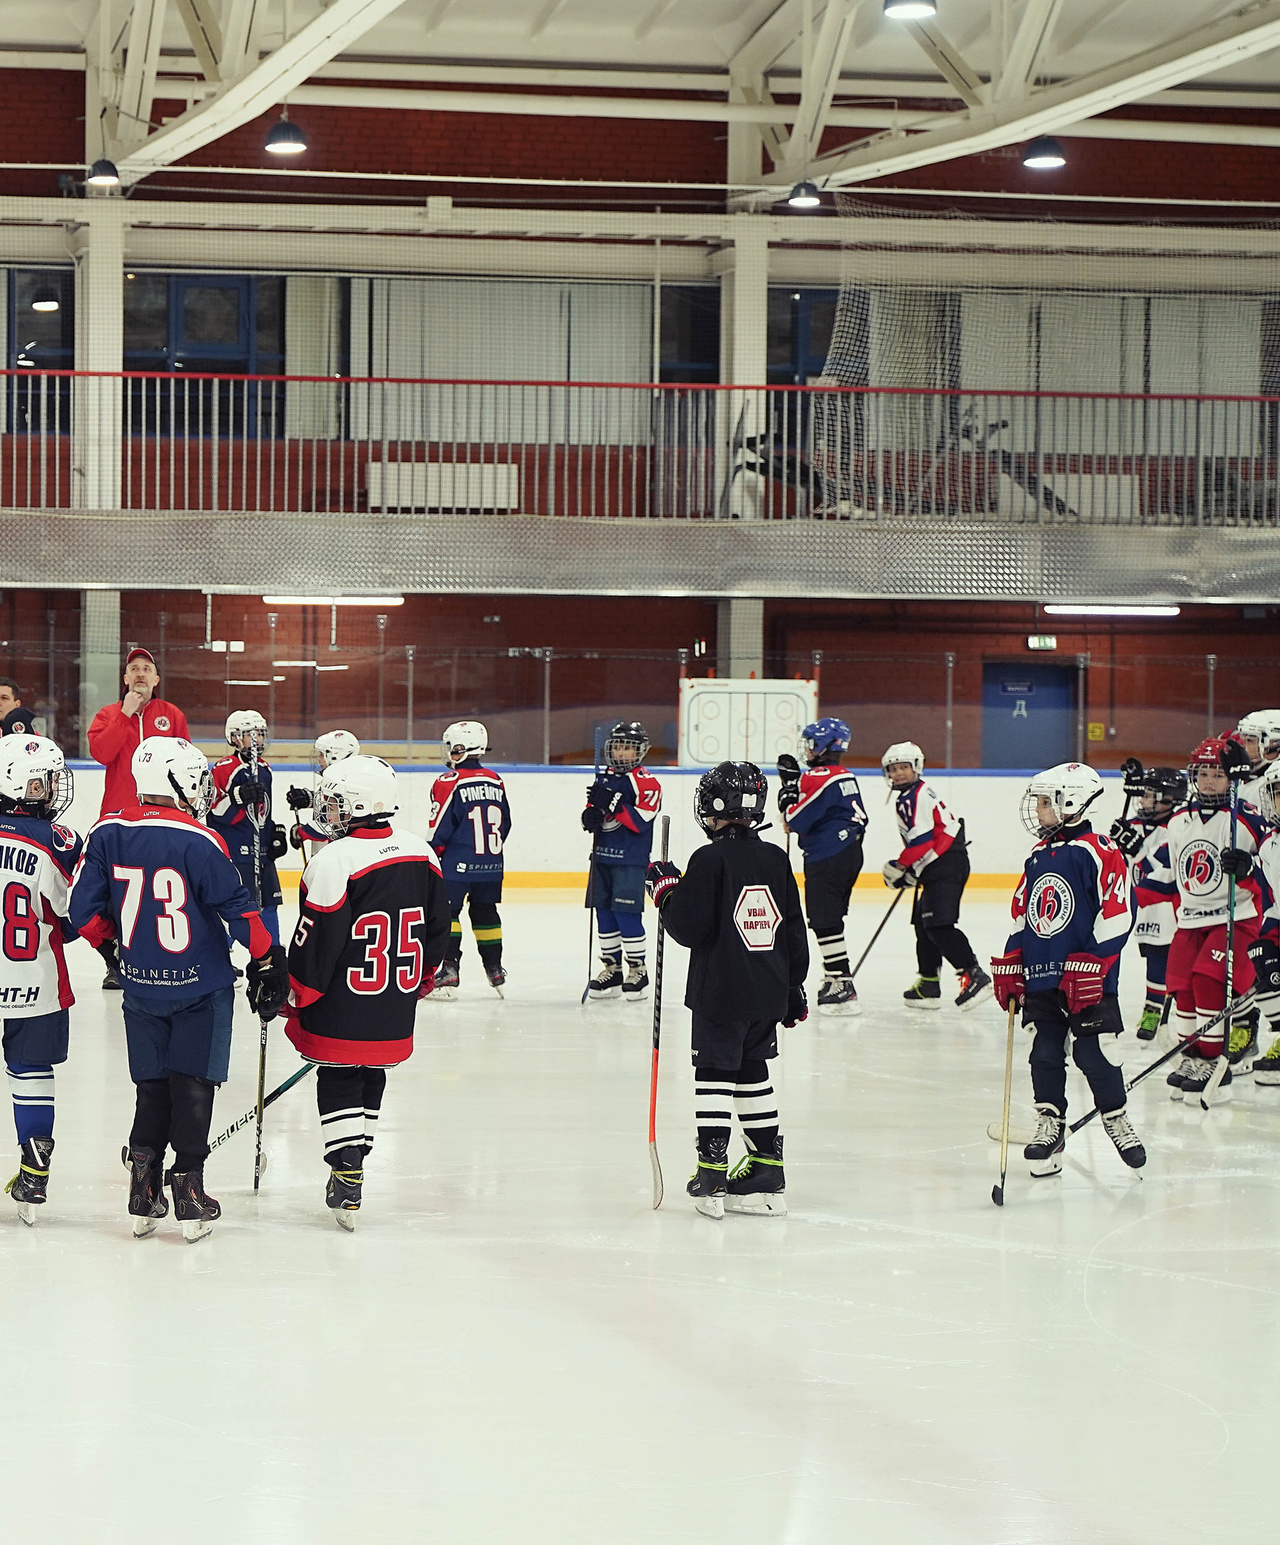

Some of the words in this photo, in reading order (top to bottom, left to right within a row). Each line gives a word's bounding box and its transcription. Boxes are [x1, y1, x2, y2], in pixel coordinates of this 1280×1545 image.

[142, 753, 153, 763] 73
[468, 805, 503, 855] 13
[379, 845, 400, 855] LUTCH
[1032, 878, 1052, 898] HOCKEY
[1102, 872, 1126, 905] 24
[112, 864, 191, 954] 73
[347, 906, 425, 995] 35
[172, 976, 199, 986] SOLUTIONS
[209, 1105, 259, 1152] BAUER
